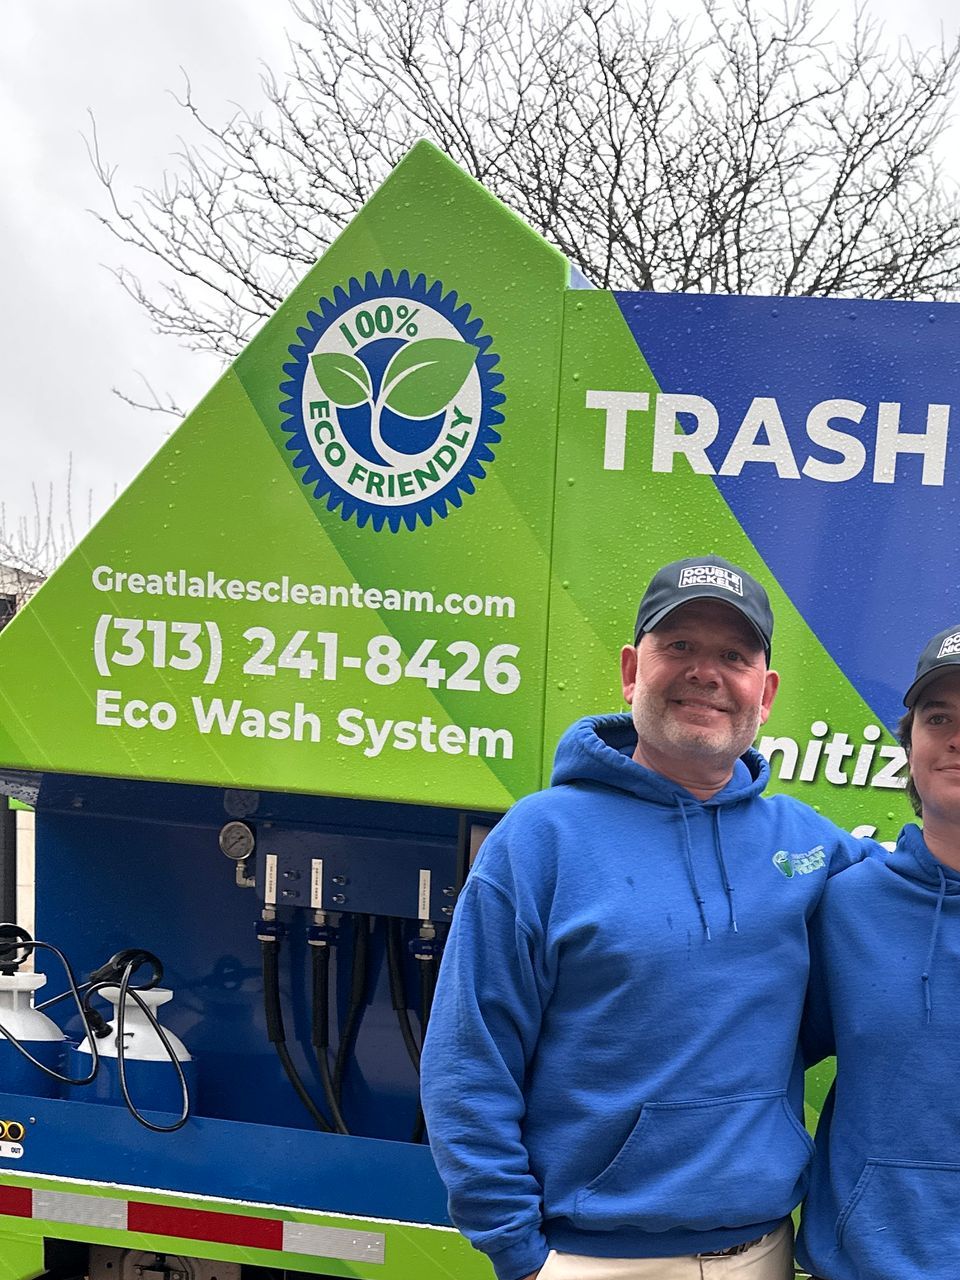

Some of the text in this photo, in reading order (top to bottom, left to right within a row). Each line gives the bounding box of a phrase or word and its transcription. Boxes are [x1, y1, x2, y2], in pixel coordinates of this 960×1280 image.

[339, 304, 420, 349] 100%
[309, 400, 473, 498] ECO FRIENDLY
[585, 390, 950, 487] TRASH
[91, 564, 516, 618] Greatlakescleanteam.com
[682, 575, 733, 590] NICKEL
[683, 567, 740, 584] DOUBLE
[93, 614, 521, 695] (313) 241-8426
[95, 689, 514, 759] Eco Wash System
